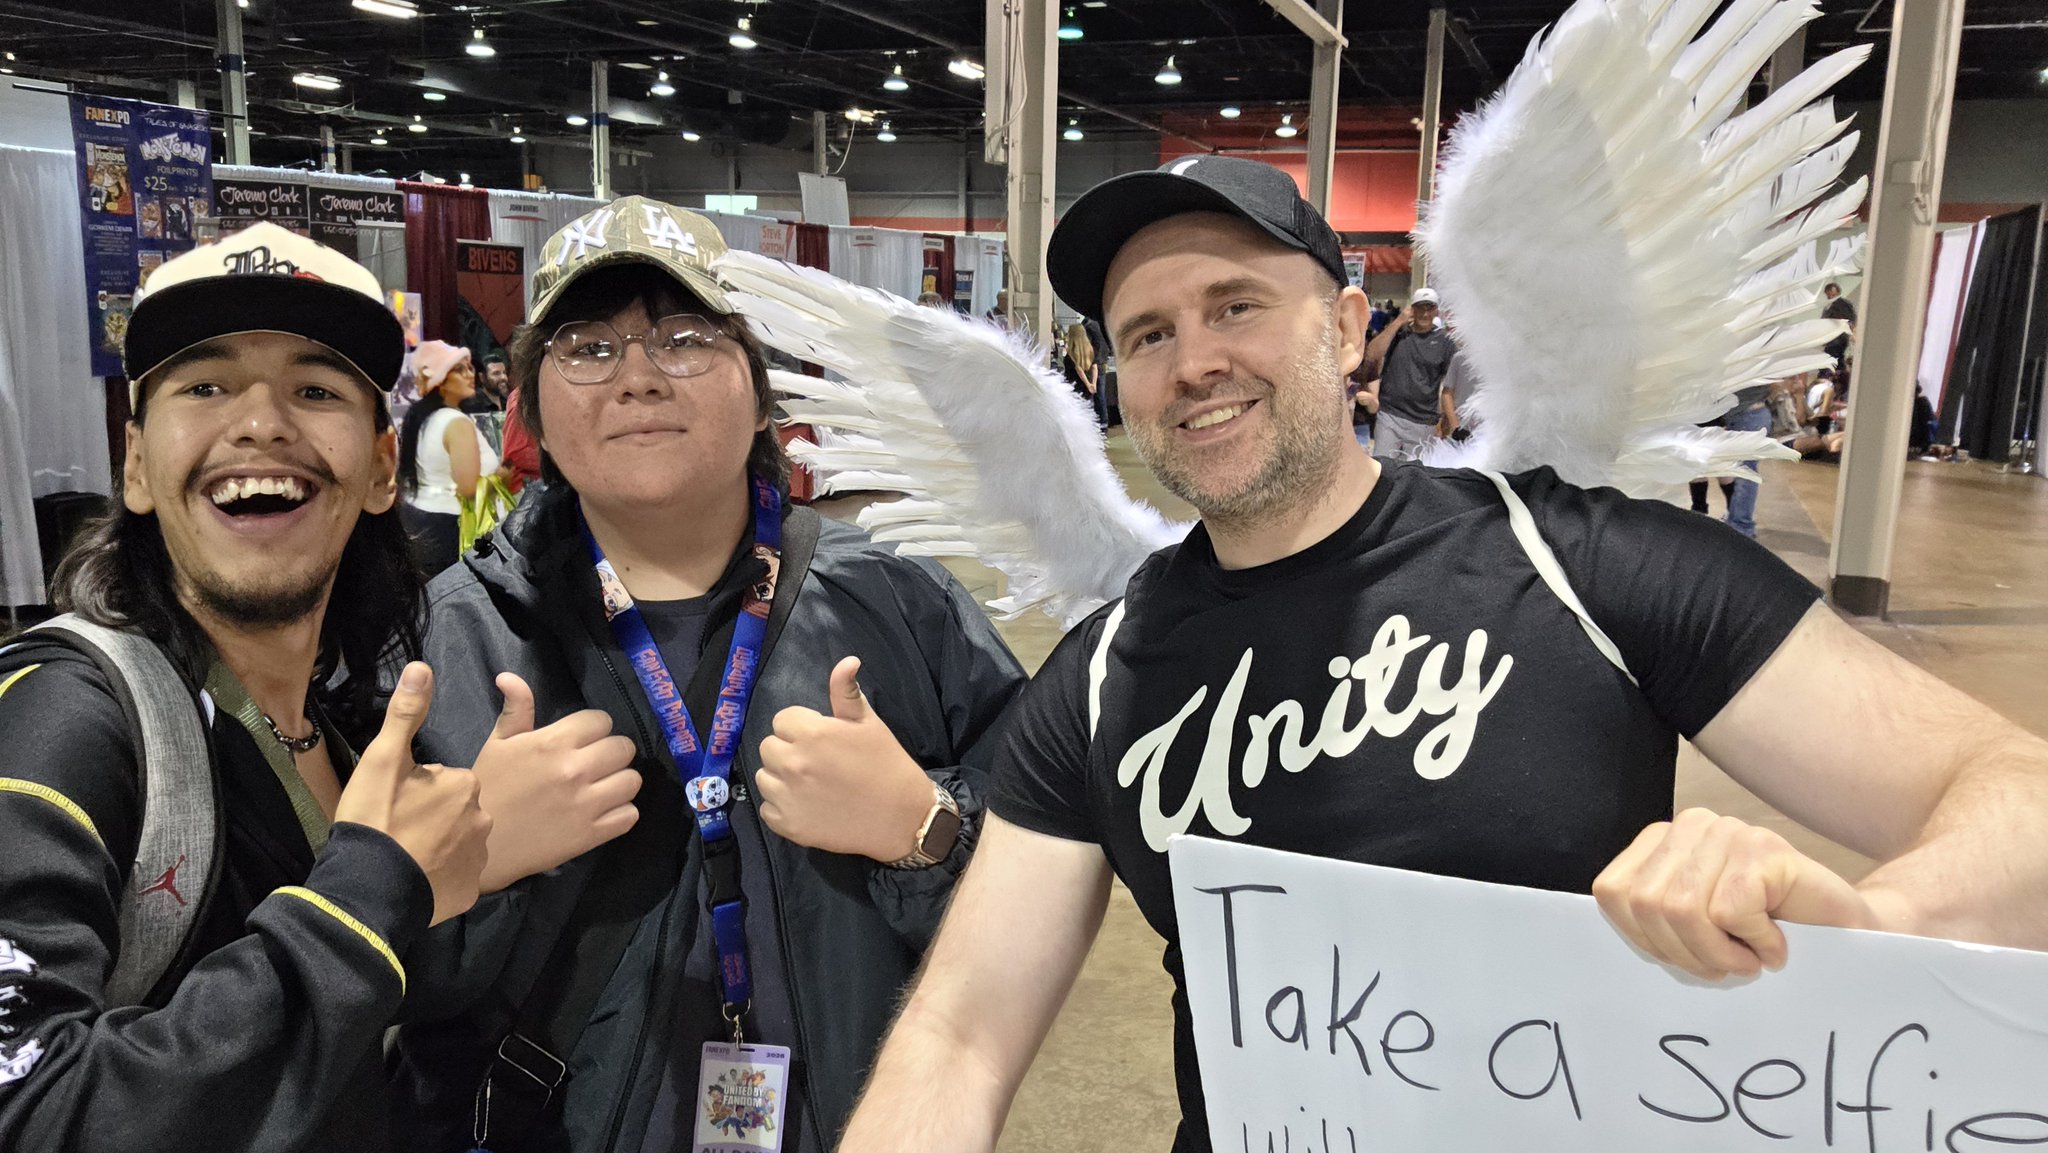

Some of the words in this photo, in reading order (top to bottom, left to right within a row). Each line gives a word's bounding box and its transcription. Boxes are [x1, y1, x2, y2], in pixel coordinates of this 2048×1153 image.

[85, 106, 130, 125] FANEXPO
[144, 176, 168, 191] $25
[220, 186, 269, 216] Jeremy
[320, 194, 365, 223] Jeremy
[556, 207, 618, 267] NY
[641, 203, 699, 257] LA
[468, 246, 518, 273] BIVENS
[1117, 614, 1514, 853] Unity
[1194, 884, 1440, 1091] Take
[1489, 1020, 1582, 1121] a
[723, 1085, 753, 1095] UNITED
[752, 1087, 764, 1096] BY
[723, 1095, 762, 1106] FANDOM
